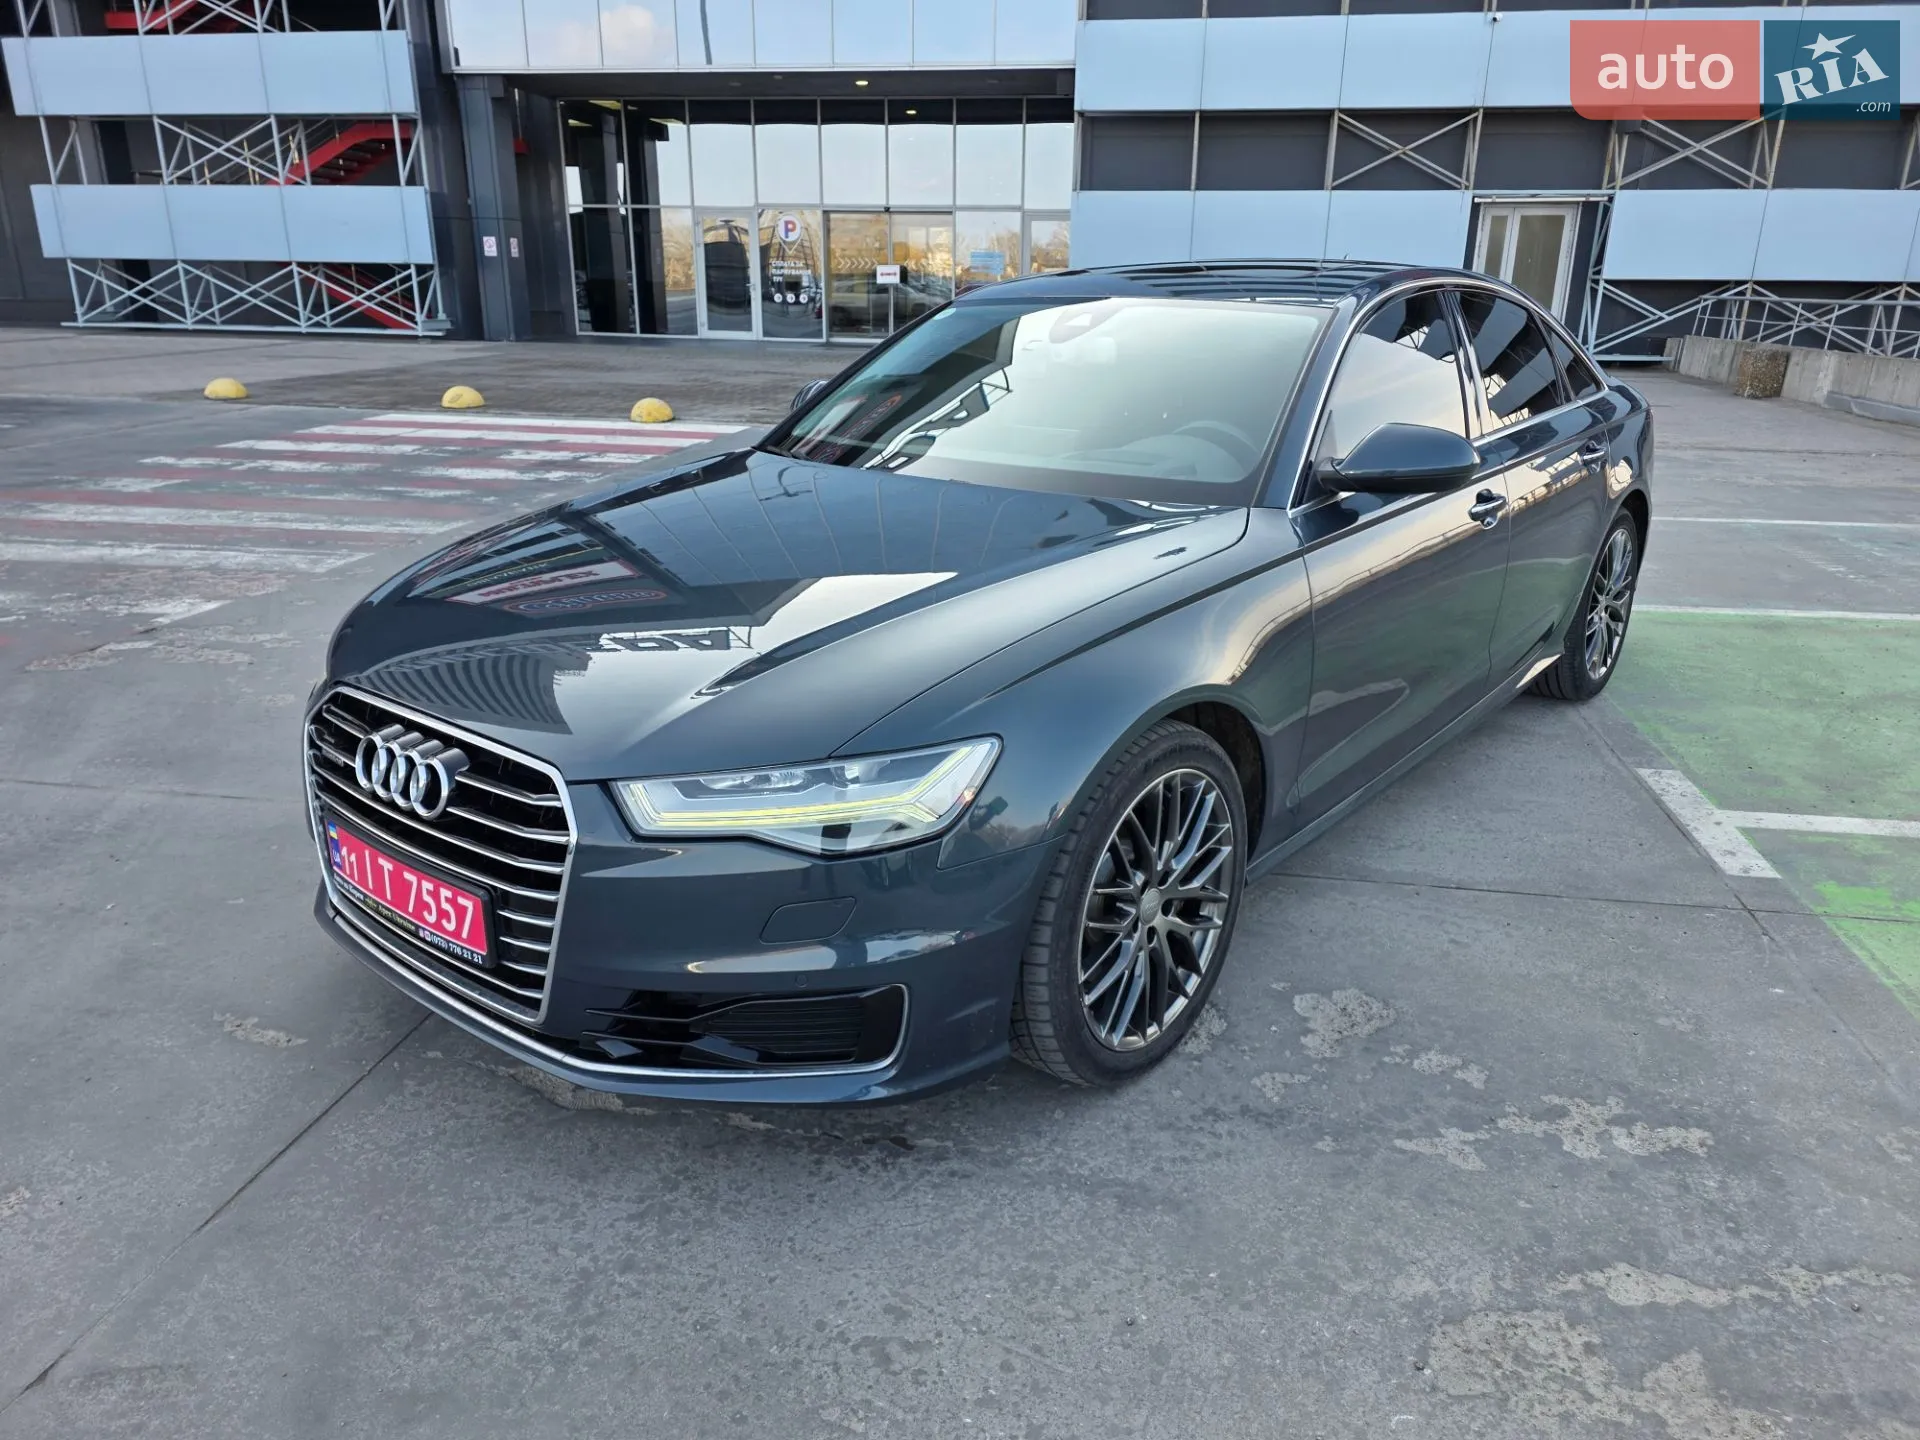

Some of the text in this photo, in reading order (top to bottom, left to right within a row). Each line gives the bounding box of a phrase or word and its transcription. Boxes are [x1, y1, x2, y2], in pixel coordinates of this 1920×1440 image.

[784, 220, 797, 239] P
[333, 850, 341, 865] UA
[341, 846, 359, 882] 11
[403, 871, 474, 940] 7557
